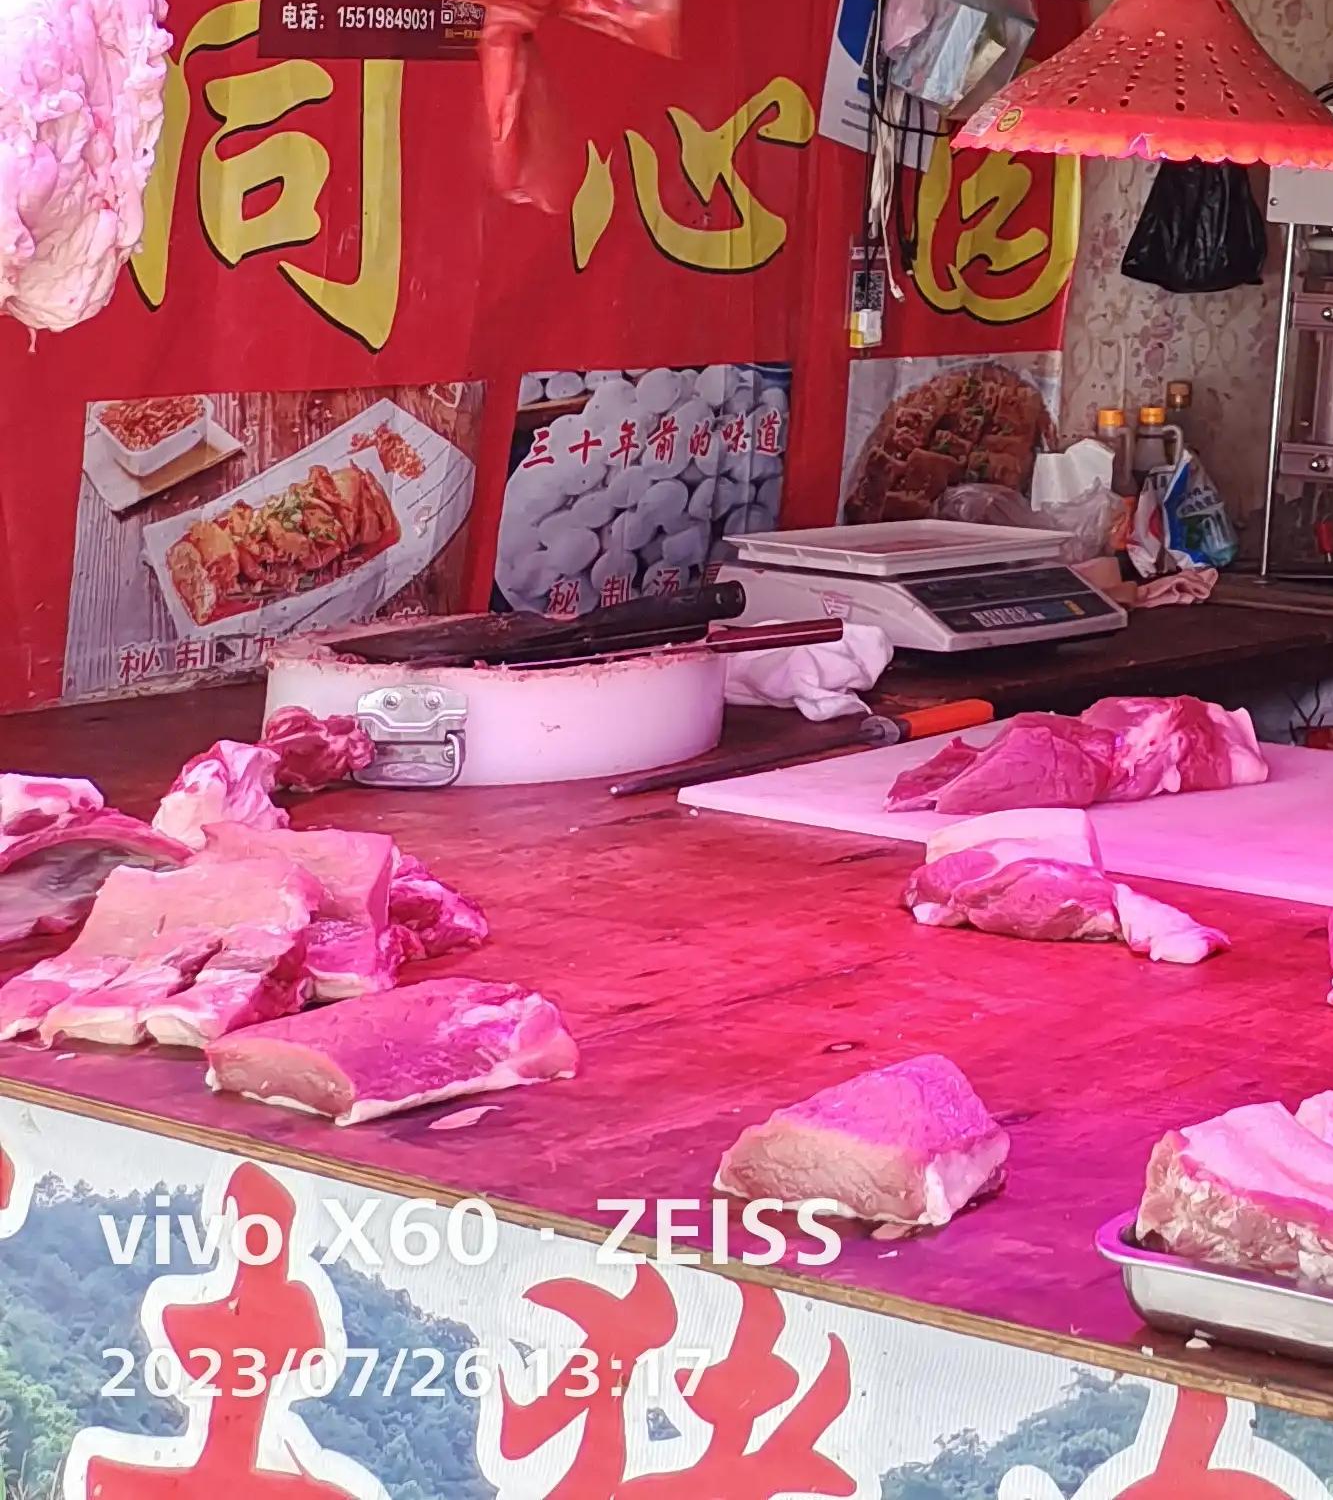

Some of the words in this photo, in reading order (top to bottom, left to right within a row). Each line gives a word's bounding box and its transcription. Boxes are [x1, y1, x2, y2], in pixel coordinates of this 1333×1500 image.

[337, 7, 435, 31] 15519849031
[522, 409, 781, 468] 三十年前的味道
[546, 562, 723, 615] 秘制汤
